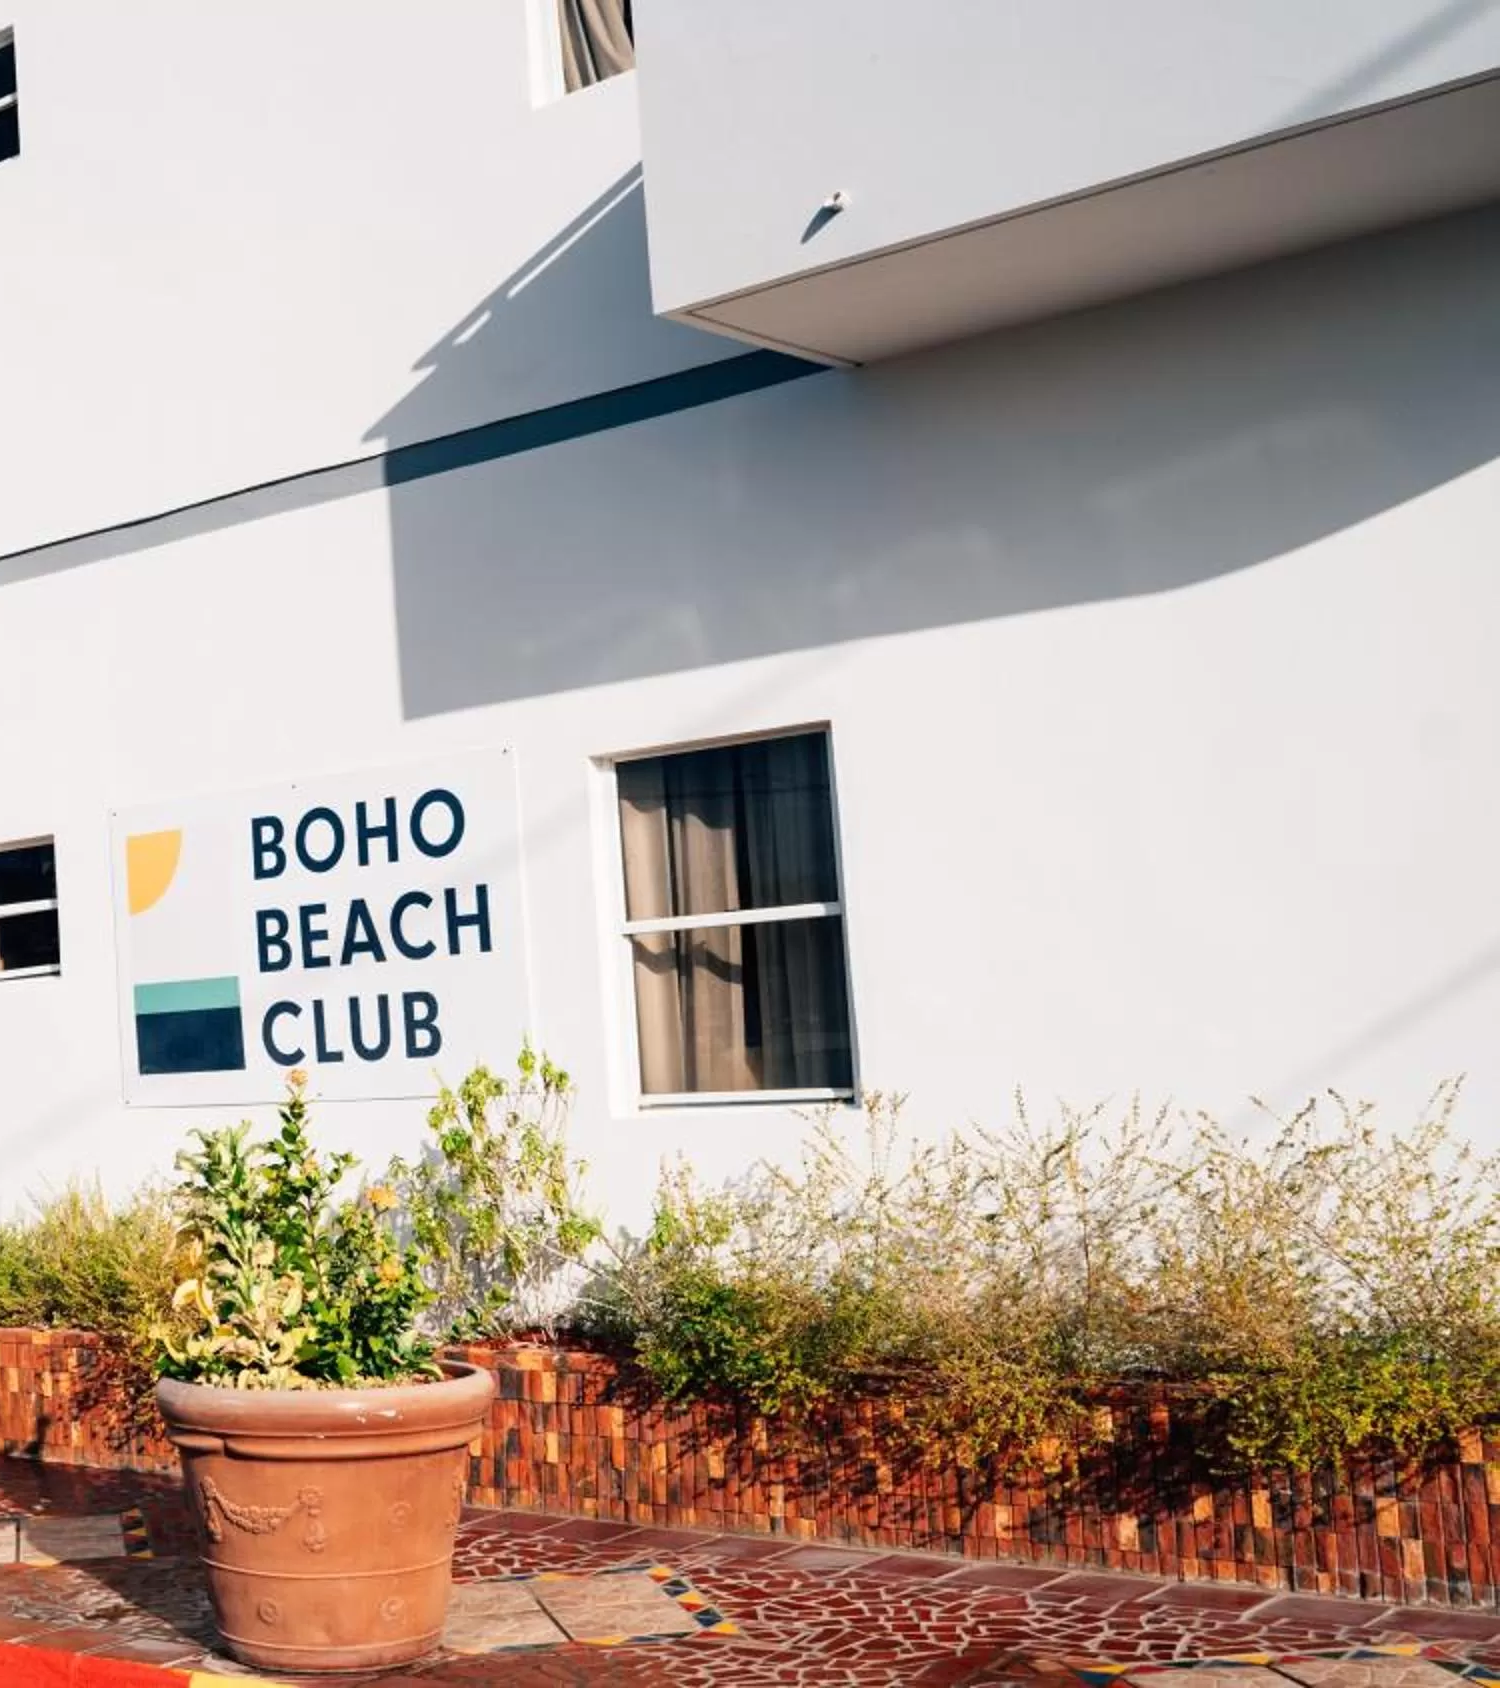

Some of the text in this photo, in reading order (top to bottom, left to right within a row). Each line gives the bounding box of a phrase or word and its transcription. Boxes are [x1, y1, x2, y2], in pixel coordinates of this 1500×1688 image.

[252, 789, 465, 880] BOHO
[256, 884, 492, 973] BEACH
[262, 991, 442, 1066] CLUB
